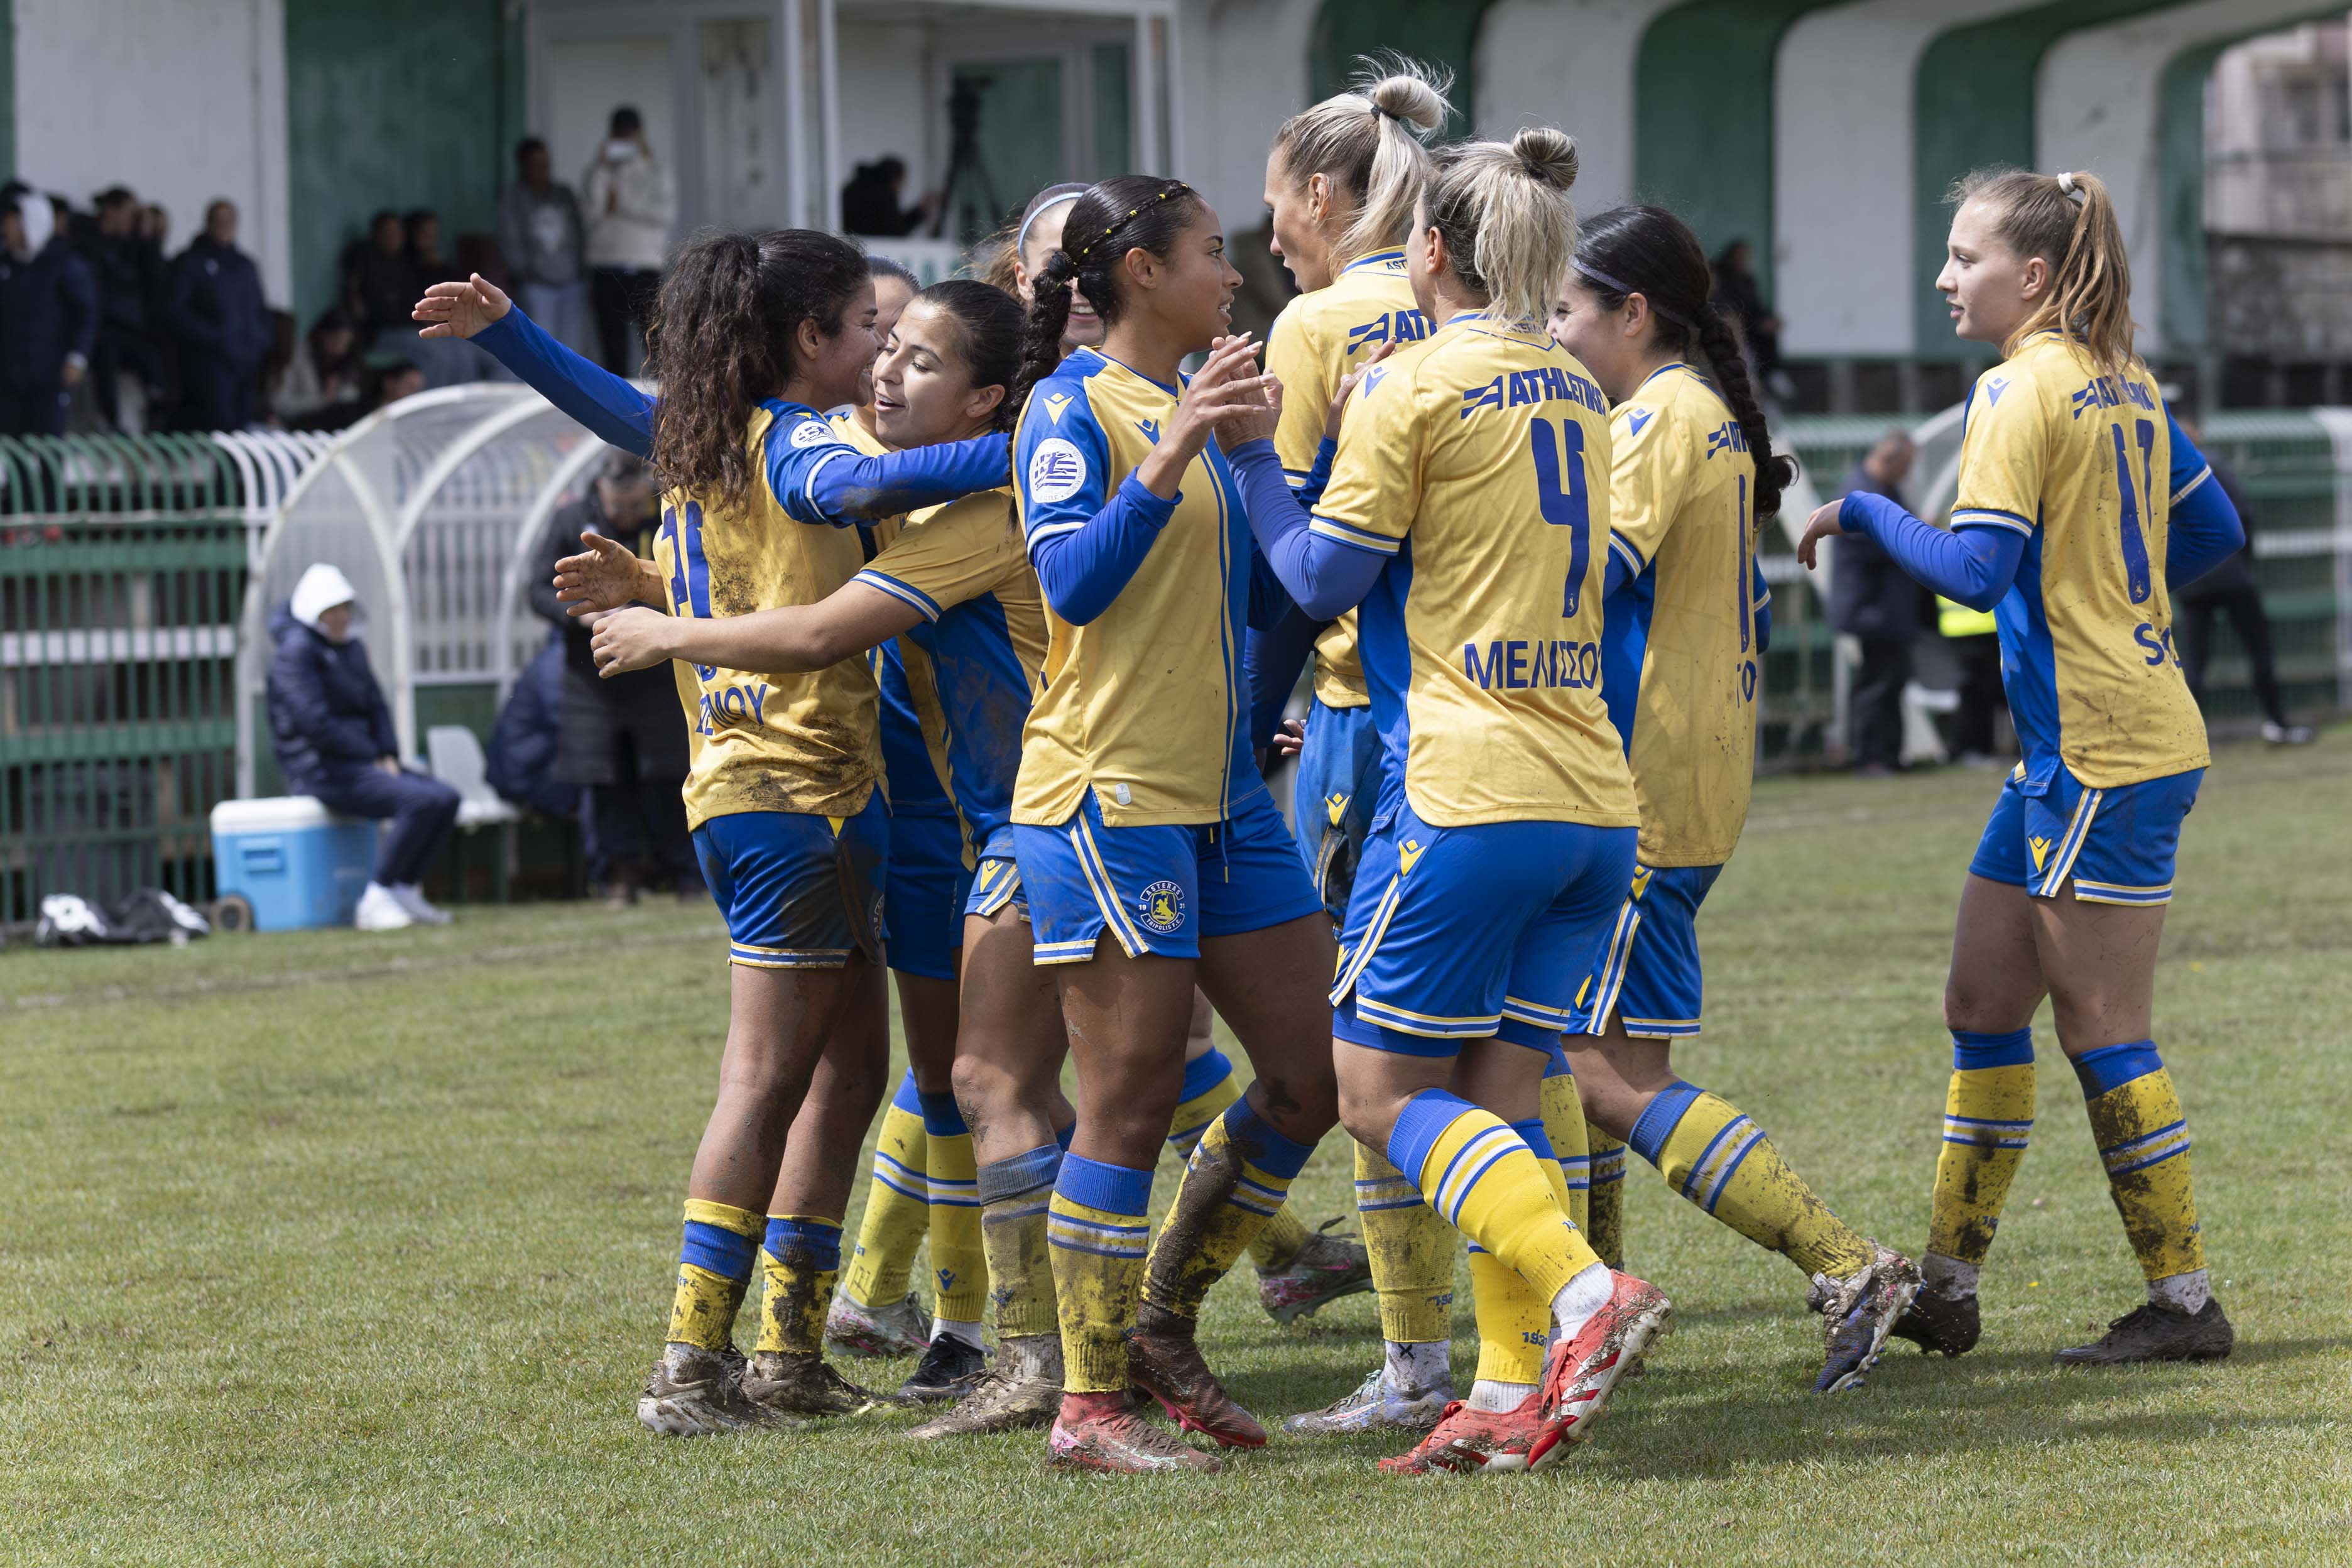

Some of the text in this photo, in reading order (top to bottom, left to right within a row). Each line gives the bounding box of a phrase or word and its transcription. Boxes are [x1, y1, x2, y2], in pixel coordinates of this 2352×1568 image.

[1530, 418, 1589, 618] 4
[2111, 418, 2155, 604] 17
[1146, 883, 1180, 895] ASTERAS
[1146, 918, 1182, 930] TRIPOLIS F.C.
